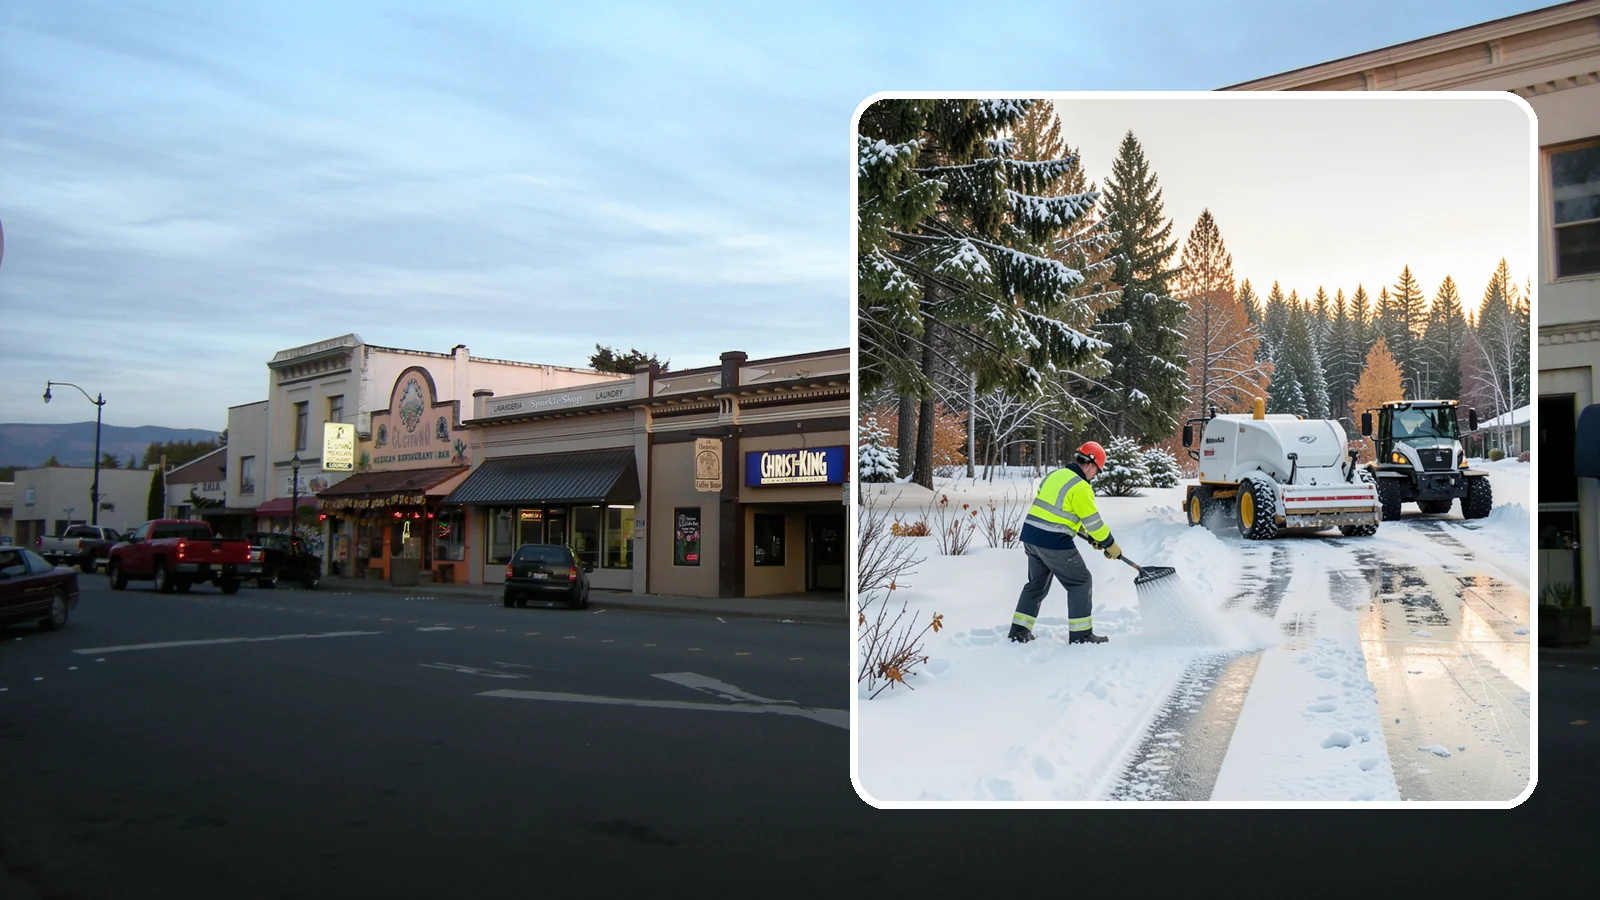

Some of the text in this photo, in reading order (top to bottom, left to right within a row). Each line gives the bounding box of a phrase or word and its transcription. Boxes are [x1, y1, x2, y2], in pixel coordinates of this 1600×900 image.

[595, 389, 624, 400] LAUNDRY
[493, 402, 522, 413] LAVANDERIA
[531, 394, 583, 409] Sparkle Shop
[760, 450, 827, 478] CHRIST KING
